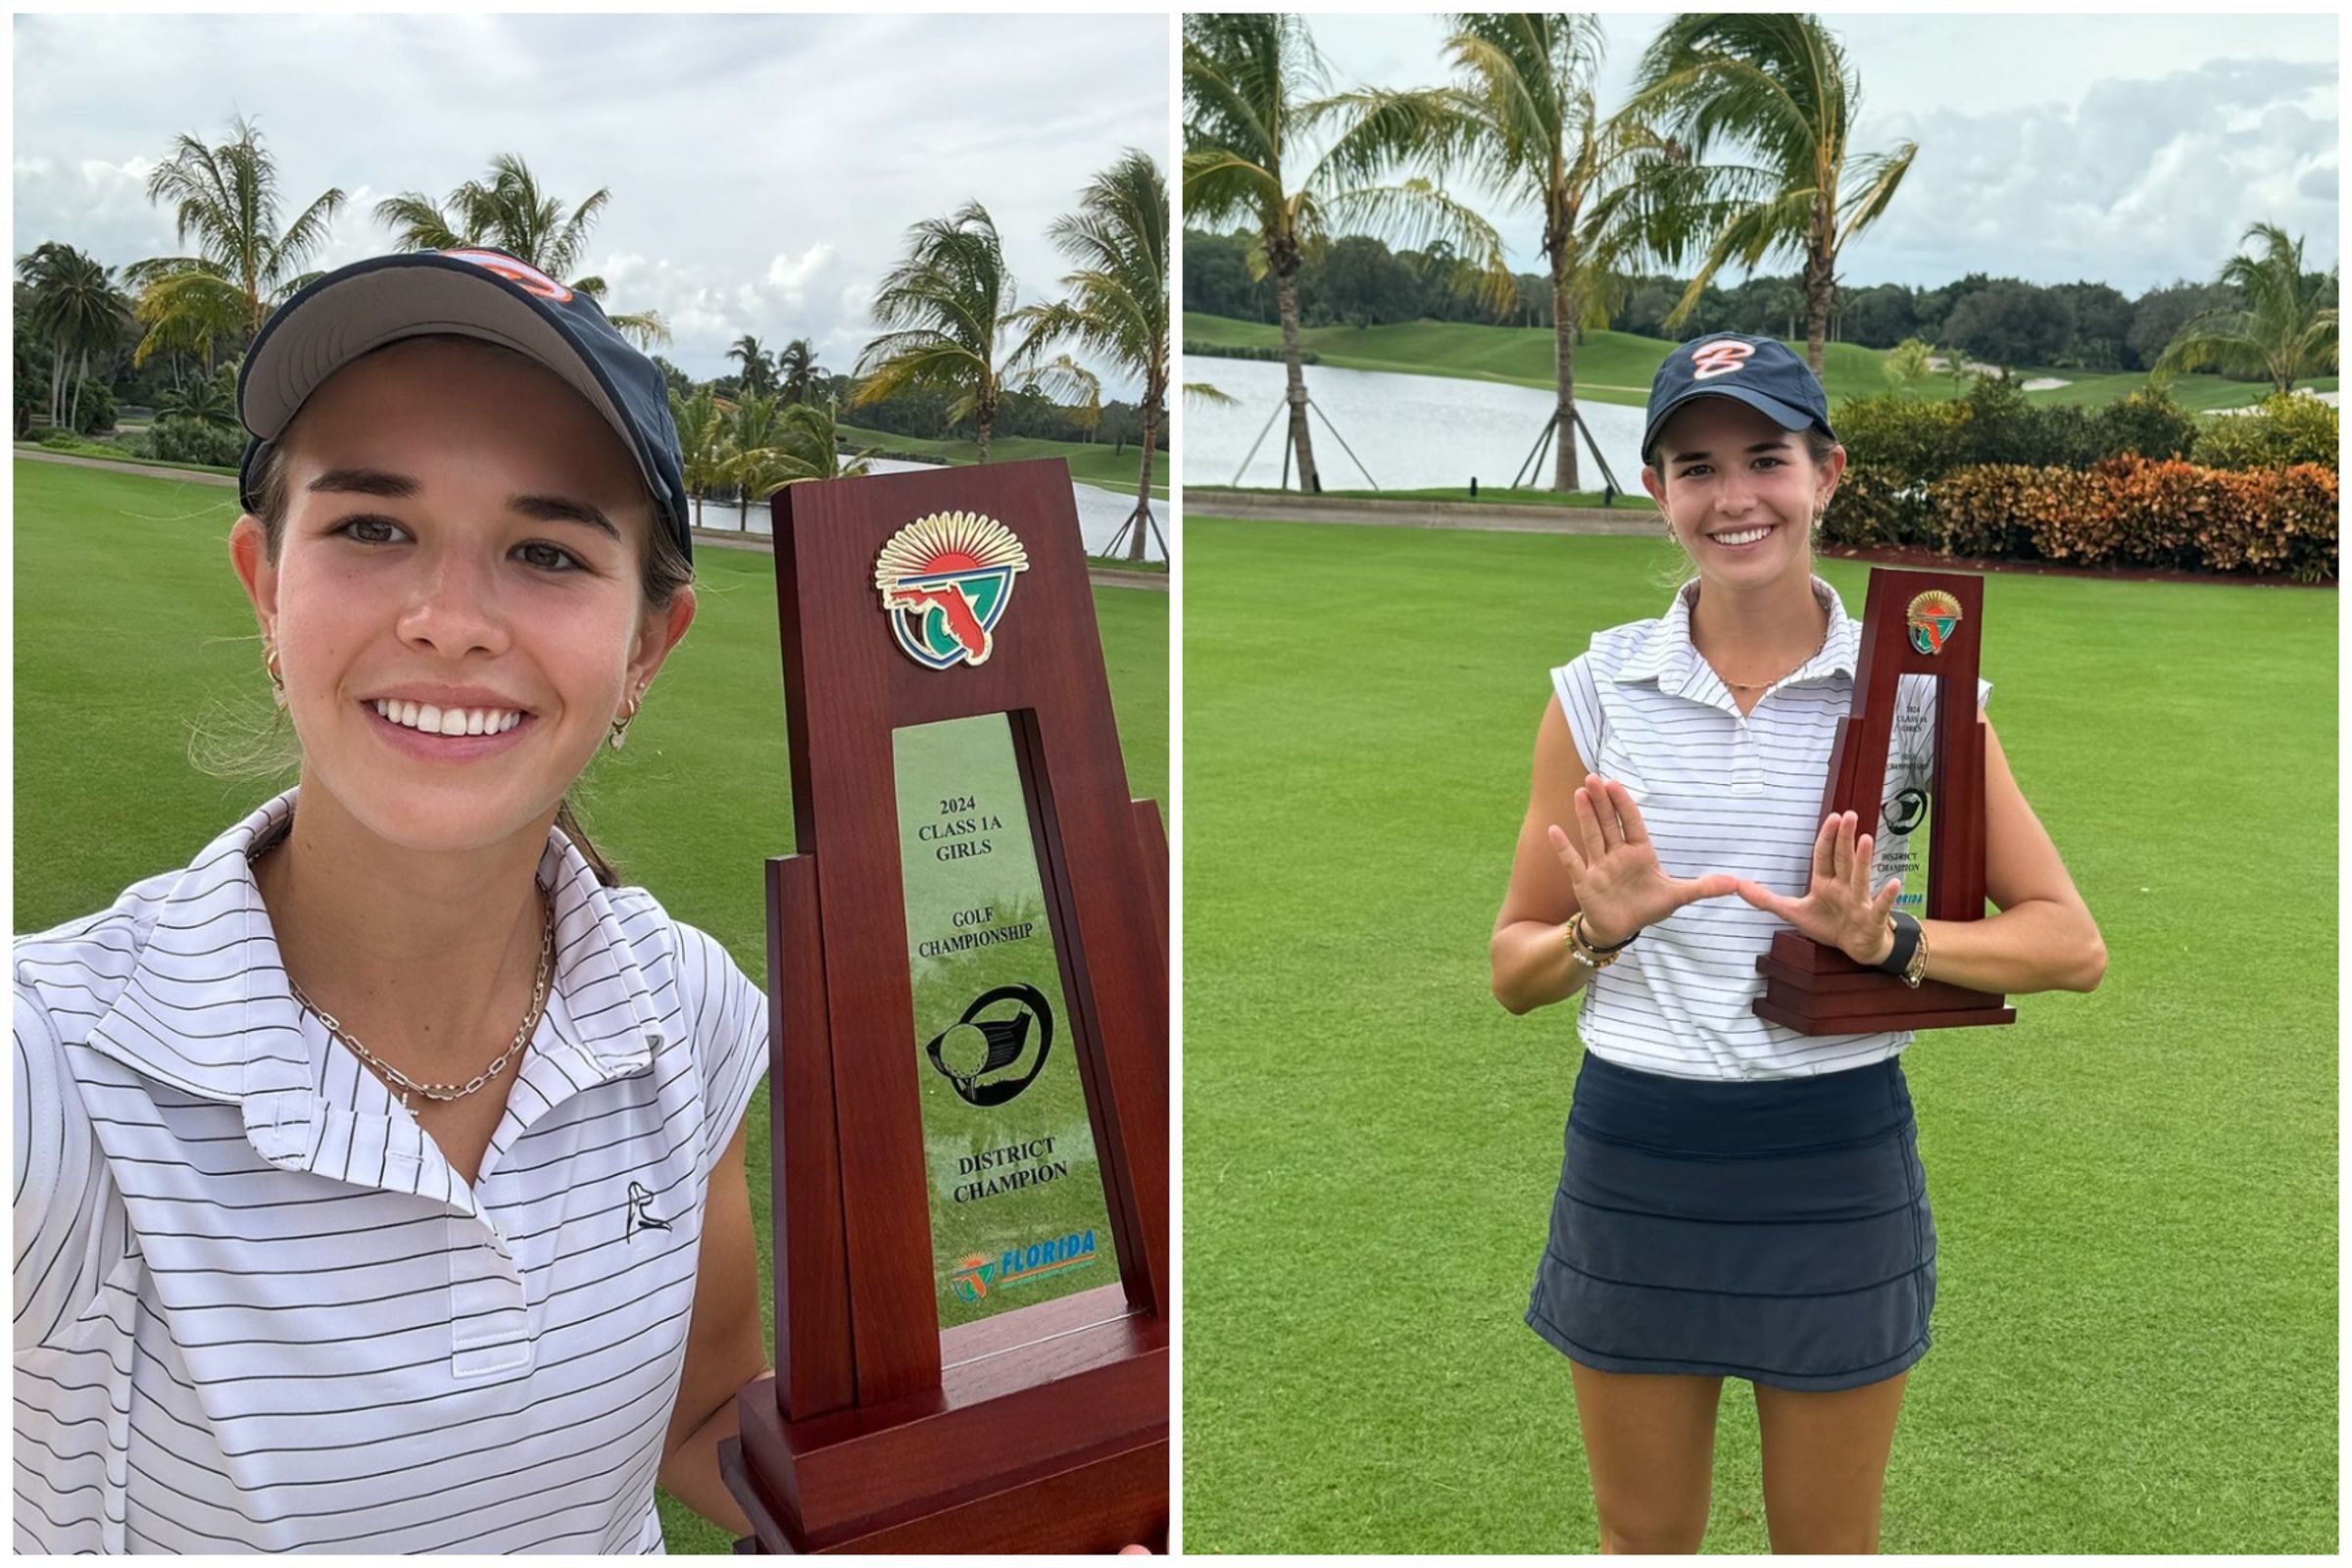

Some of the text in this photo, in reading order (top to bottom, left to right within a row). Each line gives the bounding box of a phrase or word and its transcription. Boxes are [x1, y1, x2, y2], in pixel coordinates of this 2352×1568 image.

[940, 796, 976, 814] 2024
[918, 815, 1003, 841] CLASS 1A
[936, 839, 993, 861] GIRLS
[1896, 894, 1923, 903] ORIDA
[953, 906, 995, 928] GOLF
[918, 922, 1033, 957] CHAMPIONSHIP
[958, 1136, 1055, 1176] DISTRICT
[954, 1160, 1067, 1203] CHAMPION
[1002, 1229, 1096, 1276] FLORIDA
